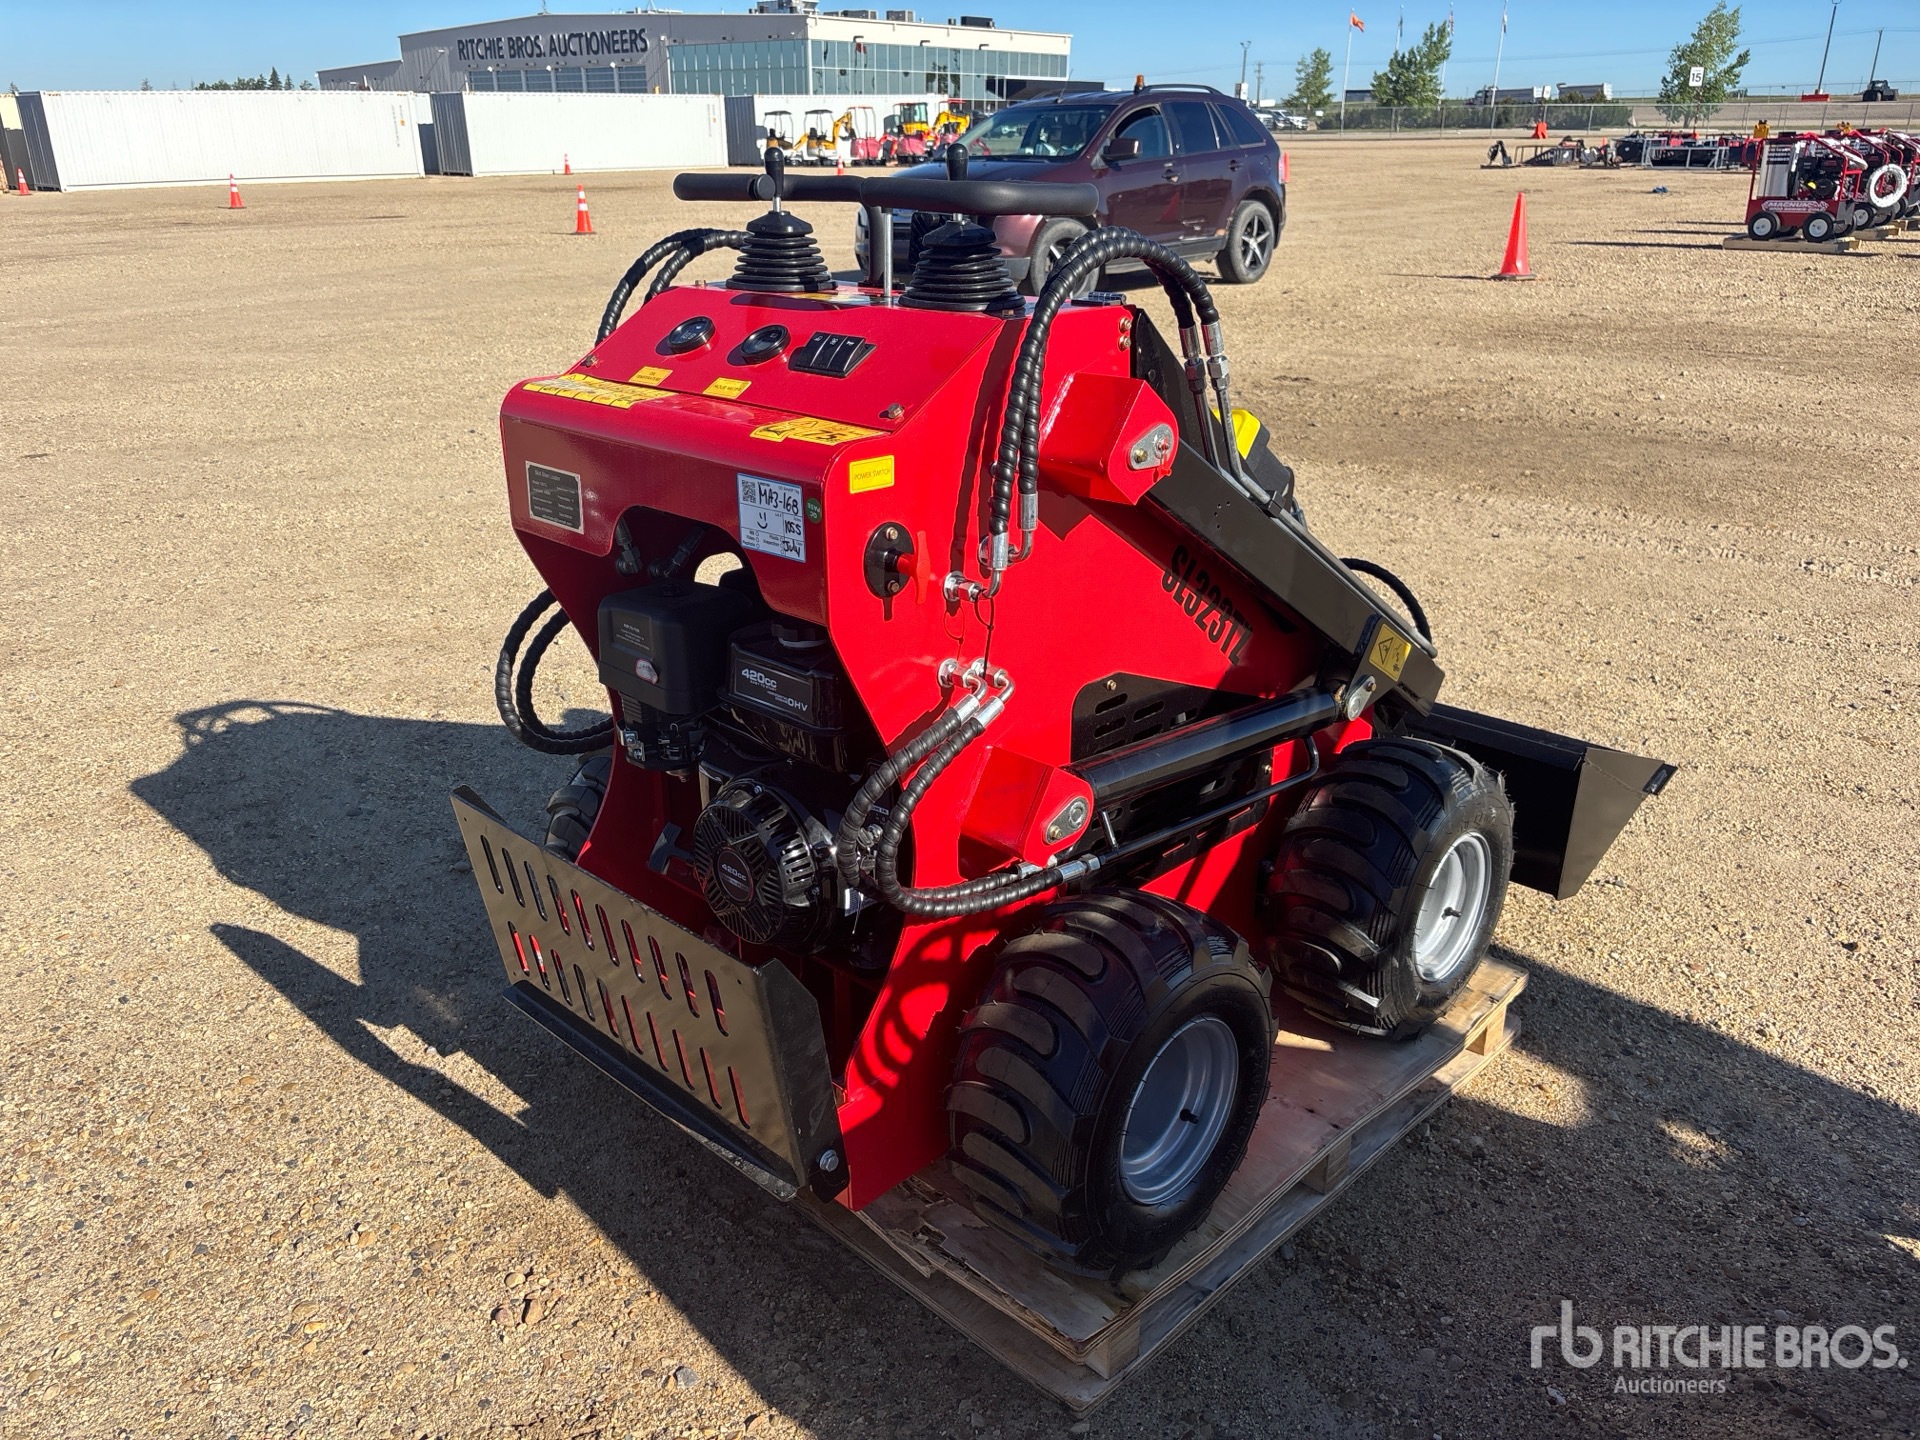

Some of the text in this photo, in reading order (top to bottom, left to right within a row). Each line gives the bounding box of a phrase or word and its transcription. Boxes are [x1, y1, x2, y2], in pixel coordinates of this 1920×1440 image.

[457, 28, 649, 60] RITCHIE BROS. AUCTIONEERS
[1691, 72, 1702, 82] 15
[854, 468, 891, 480] POWER SWITCH
[758, 482, 799, 516] MA3-168
[741, 668, 777, 688] 420cc
[721, 863, 747, 881] 420cc
